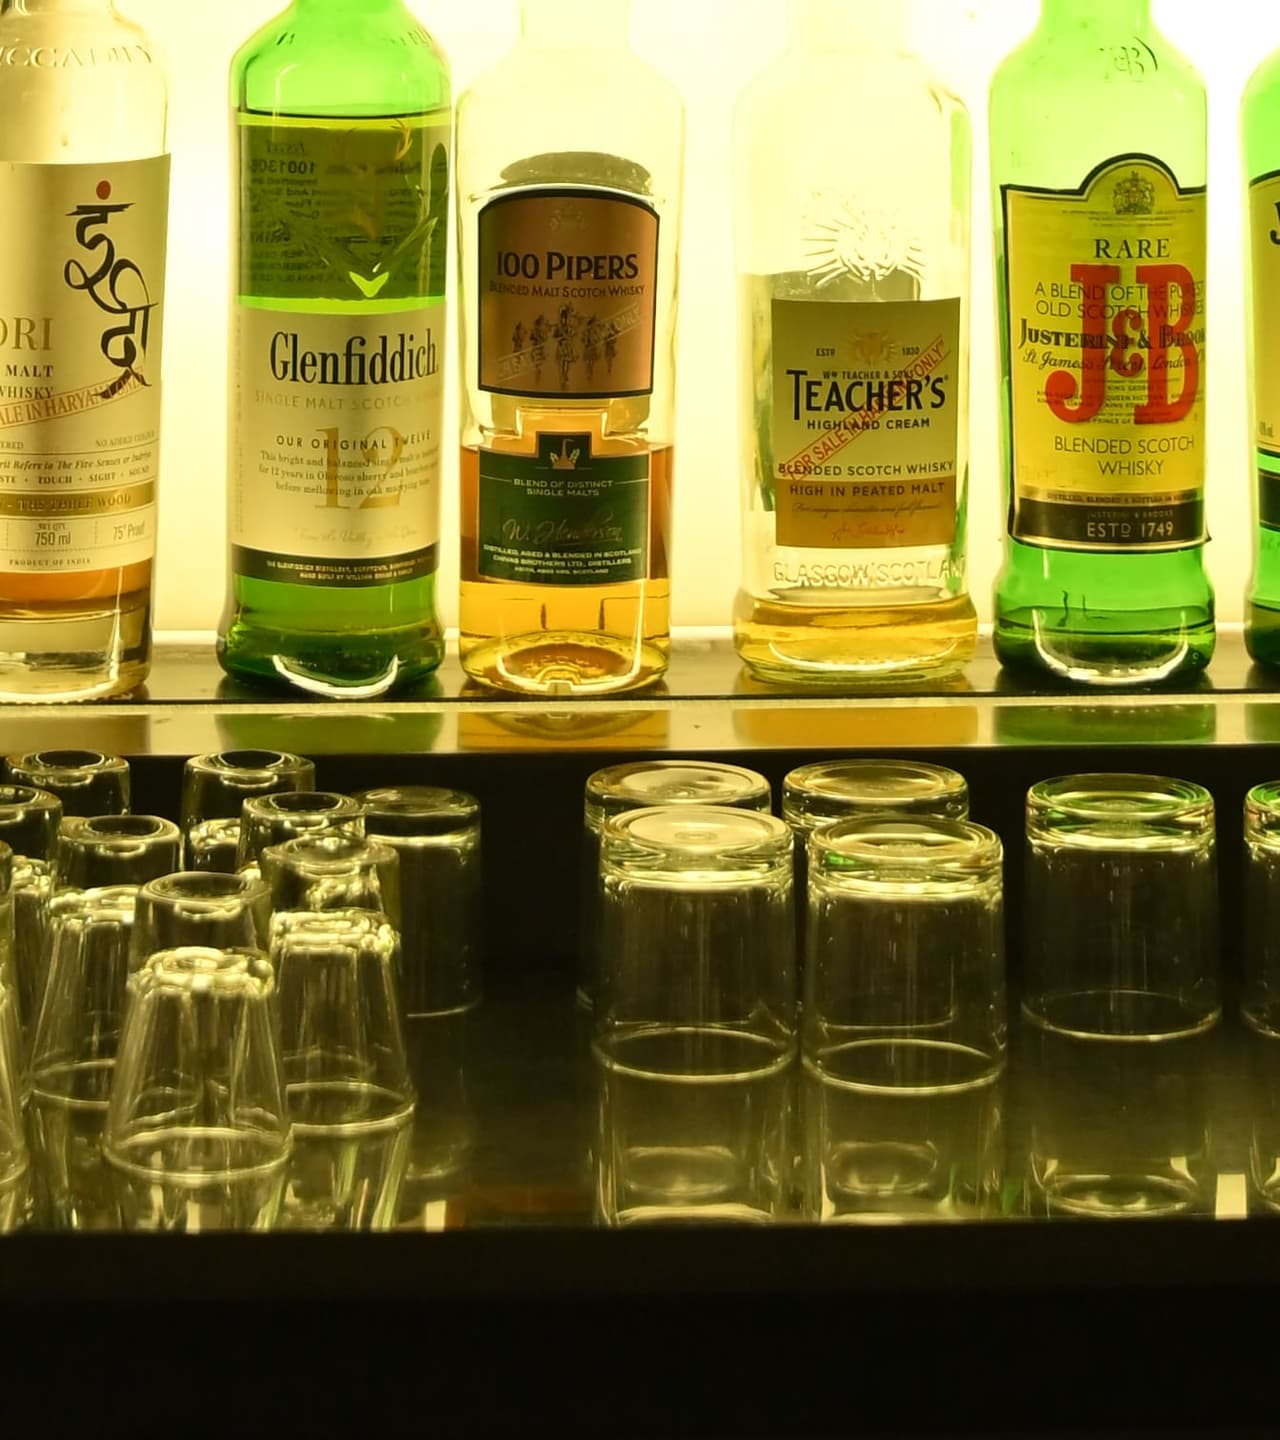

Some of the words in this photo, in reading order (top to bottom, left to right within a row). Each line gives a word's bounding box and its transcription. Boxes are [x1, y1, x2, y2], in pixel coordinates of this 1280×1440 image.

[1094, 237, 1171, 260] RARE
[495, 251, 540, 281] 100
[546, 251, 640, 282] PIPERS
[530, 286, 560, 298] MALT
[561, 286, 607, 299] SCOTCH
[1033, 280, 1047, 298] A
[1049, 281, 1106, 301] BLEND
[1035, 299, 1072, 318] OLD
[1044, 263, 1200, 426] J&B
[269, 327, 439, 388] Glenfiddich
[5, 363, 55, 378] MALT
[305, 396, 344, 411] MALT
[785, 368, 947, 422] TEACHER'S
[806, 419, 880, 432] HIGHLAND
[885, 418, 931, 430] CREAM
[275, 433, 303, 449] OUR
[310, 436, 388, 452] ORIGINAL
[1053, 434, 1132, 455] BLENDED
[1137, 435, 1195, 455] SCOTCH
[847, 462, 902, 477] SCOTCH
[905, 458, 954, 474] WHISKY
[1097, 459, 1165, 476] WHISKY
[513, 477, 548, 489] BLEND
[566, 478, 615, 489] DISTINCT
[789, 484, 824, 497] HIGH
[830, 484, 845, 497] IN
[851, 484, 906, 497] PEATED
[910, 481, 946, 496] MALT
[526, 487, 564, 498] SINGLE
[566, 487, 601, 498] MALTS
[1140, 520, 1175, 537] 1749
[32, 531, 55, 546] 750
